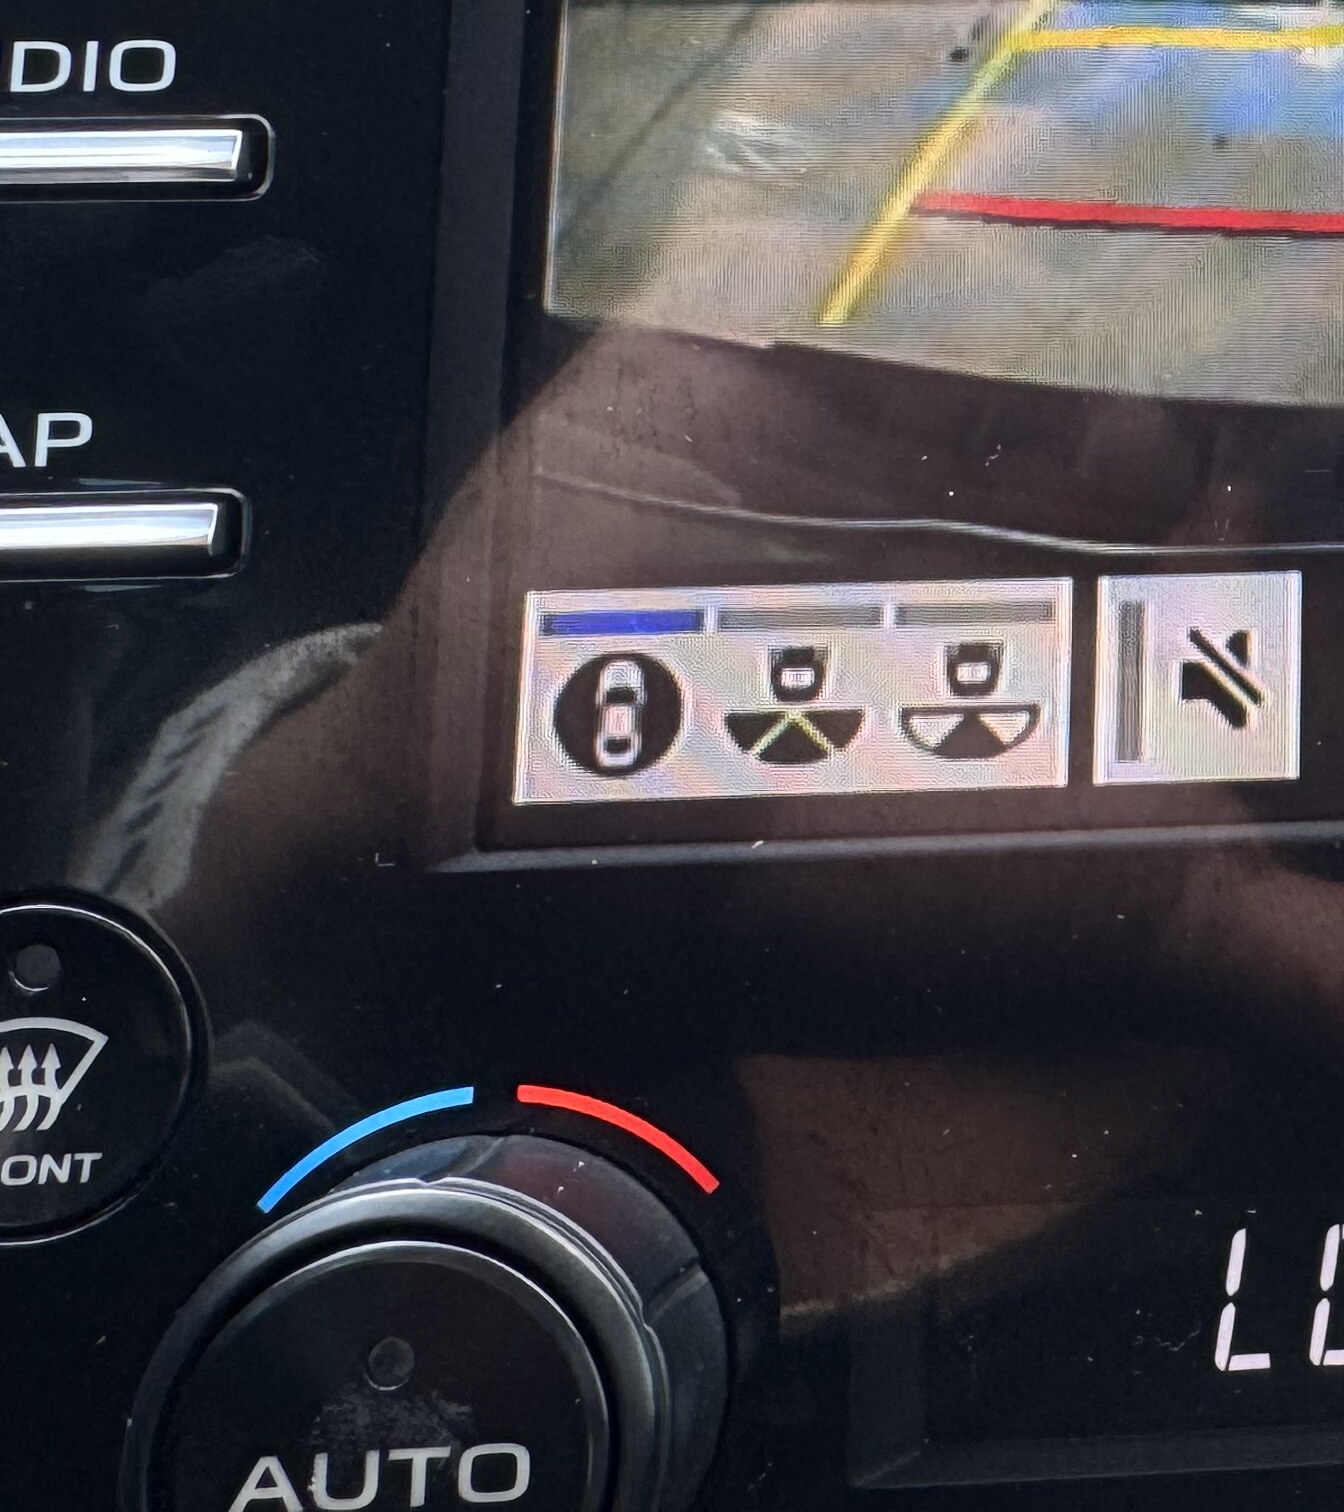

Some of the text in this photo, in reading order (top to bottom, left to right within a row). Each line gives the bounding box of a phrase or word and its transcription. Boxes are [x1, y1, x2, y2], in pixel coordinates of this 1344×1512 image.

[9, 39, 177, 93] DIO
[0, 1152, 103, 1187] ONT
[227, 1442, 531, 1512] AUTO
